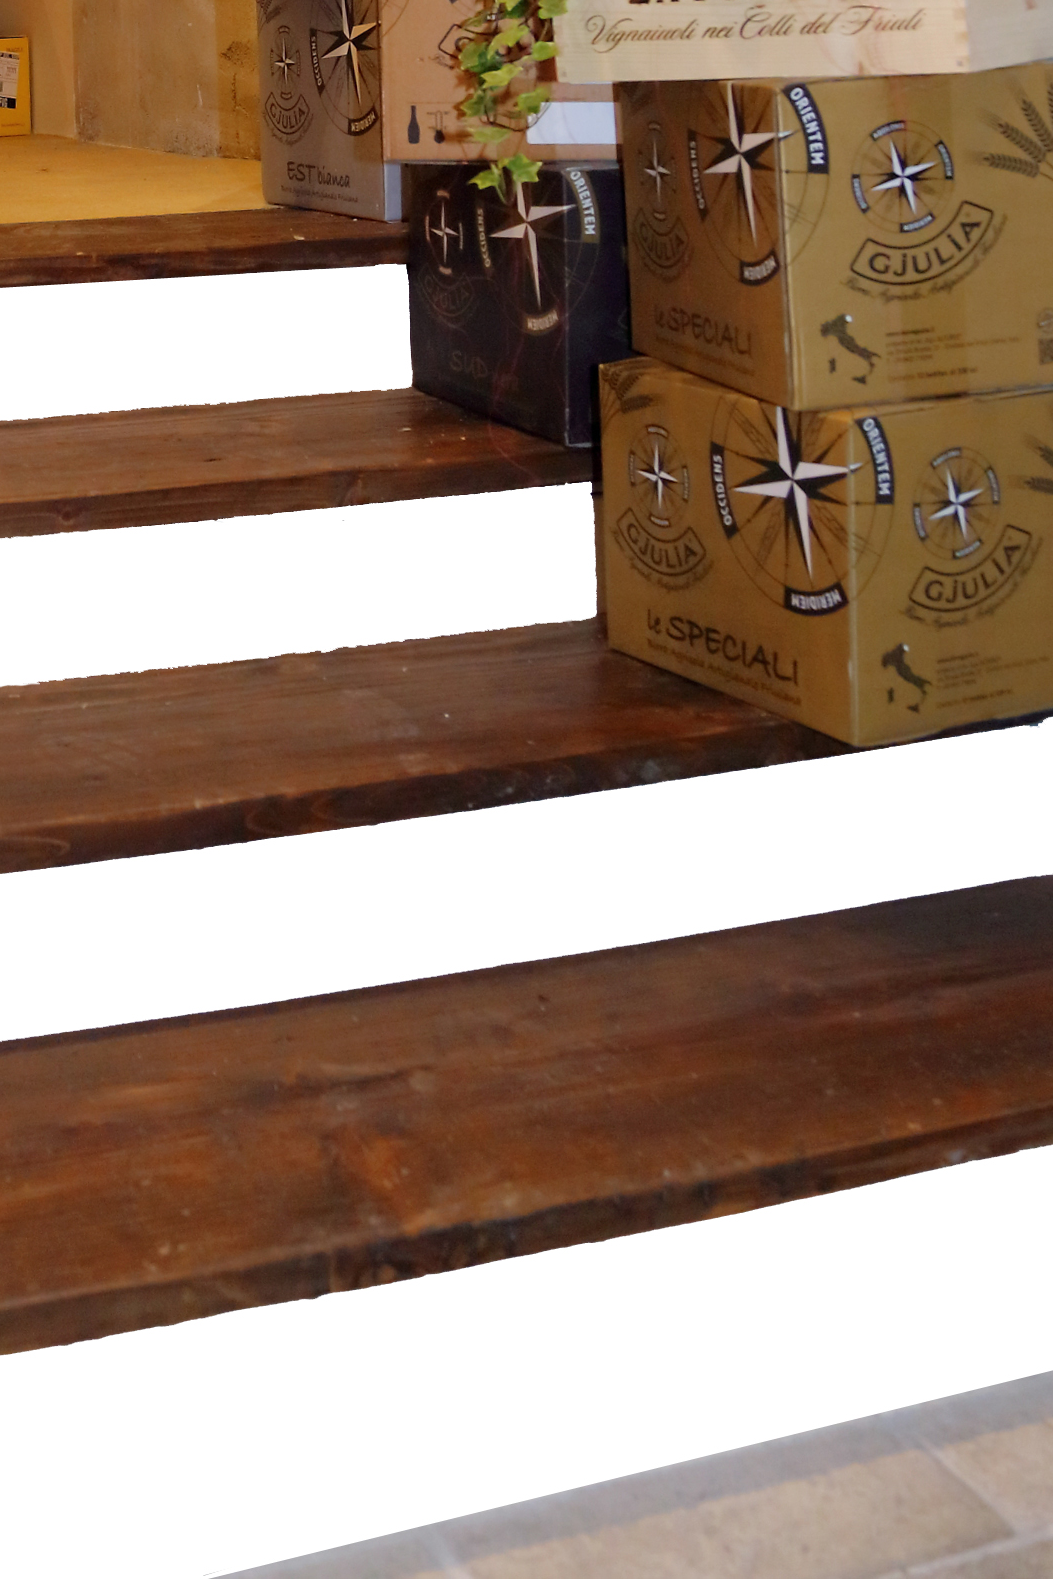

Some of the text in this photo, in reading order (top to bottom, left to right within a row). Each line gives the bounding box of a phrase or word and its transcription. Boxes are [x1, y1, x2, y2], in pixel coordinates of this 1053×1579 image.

[701, 25, 734, 40] nei
[739, 5, 794, 40] Colli
[800, 14, 834, 36] del
[841, 5, 926, 36] Friuli
[311, 36, 322, 86] OCCIDENS
[789, 88, 825, 165] ORIENTEM
[286, 161, 316, 183] EST
[571, 169, 596, 236] ORIENTEM
[477, 207, 491, 268] OCCIDENS
[668, 307, 752, 359] SPECIALI
[862, 418, 891, 496] ORIENTEM
[712, 454, 732, 526] OCCIDENS
[791, 588, 842, 610] MERIDIEM
[666, 616, 799, 686] SPECIALI
